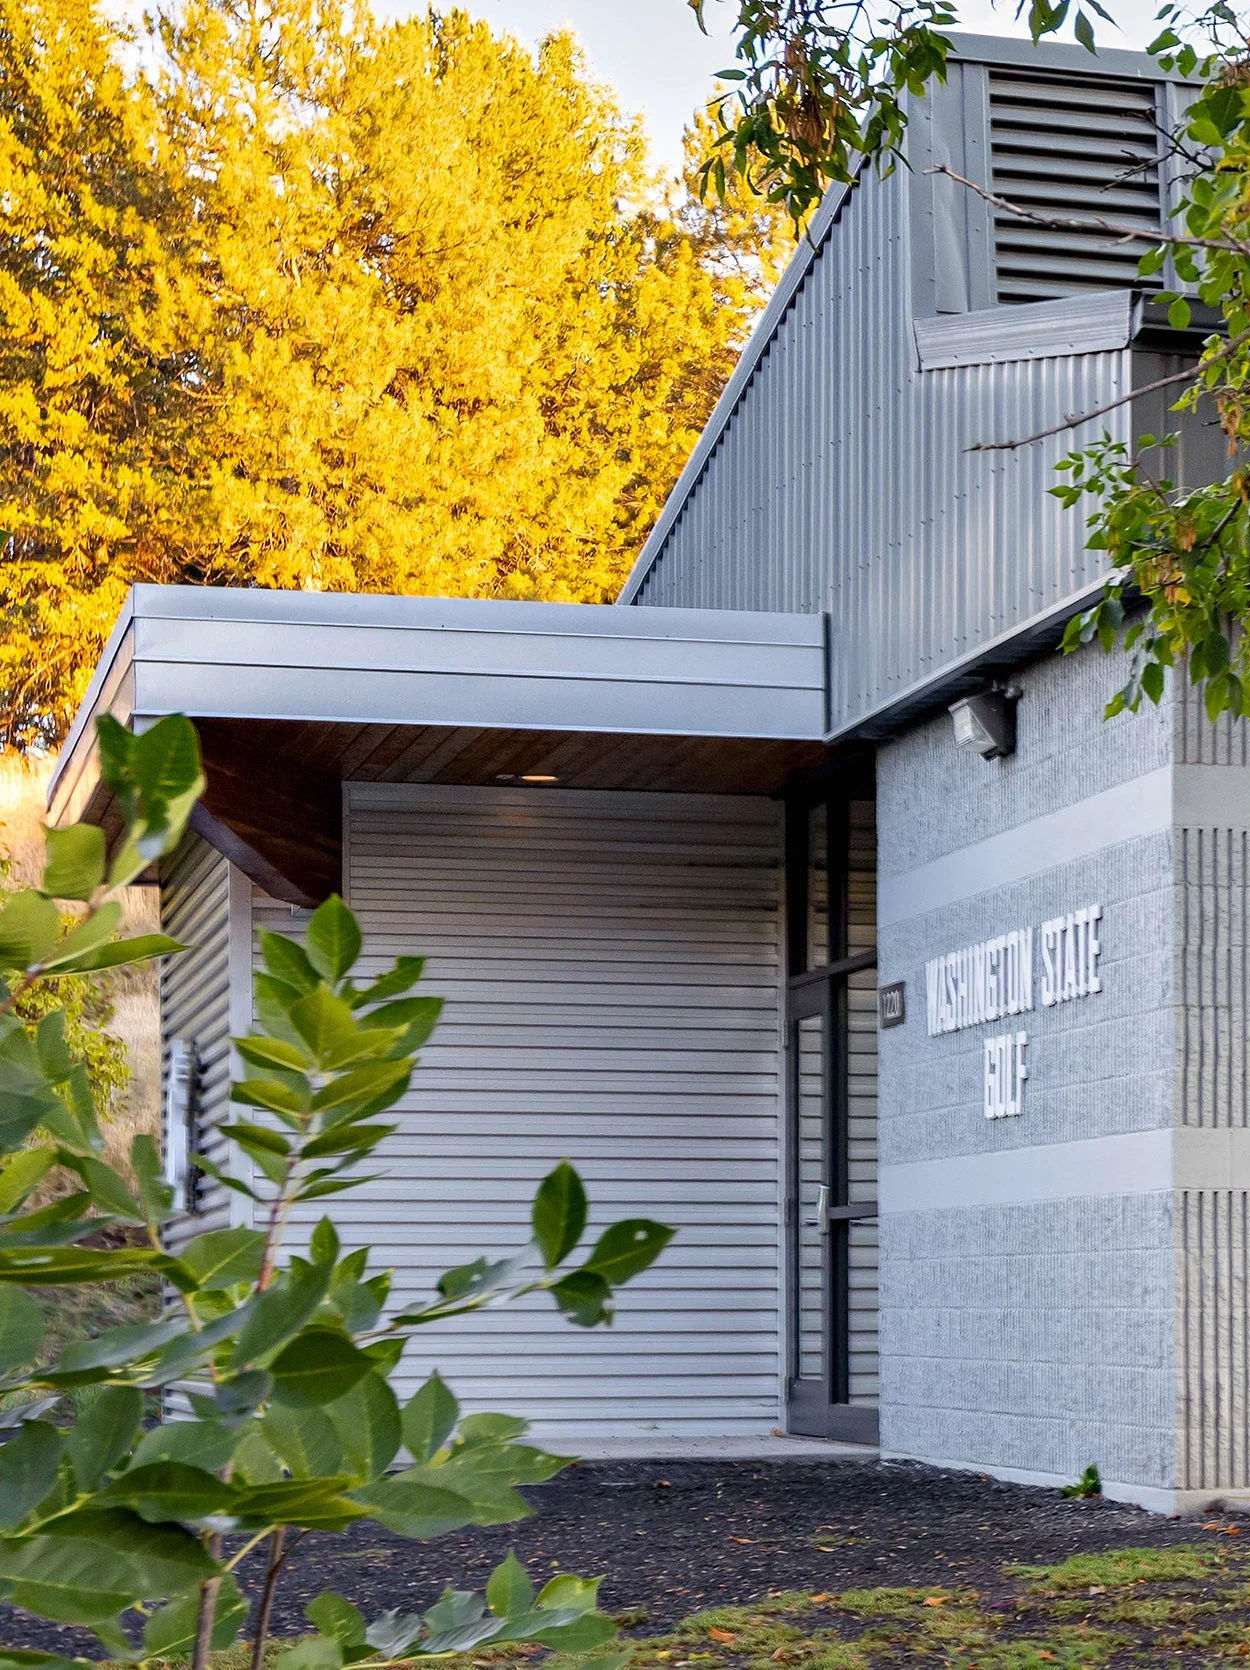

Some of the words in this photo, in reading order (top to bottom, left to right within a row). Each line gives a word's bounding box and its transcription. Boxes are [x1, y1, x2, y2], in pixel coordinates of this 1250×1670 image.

[925, 926, 1036, 1038] WASHINGTON
[1041, 904, 1103, 1007] STATE
[984, 1030, 1029, 1120] GOLF
